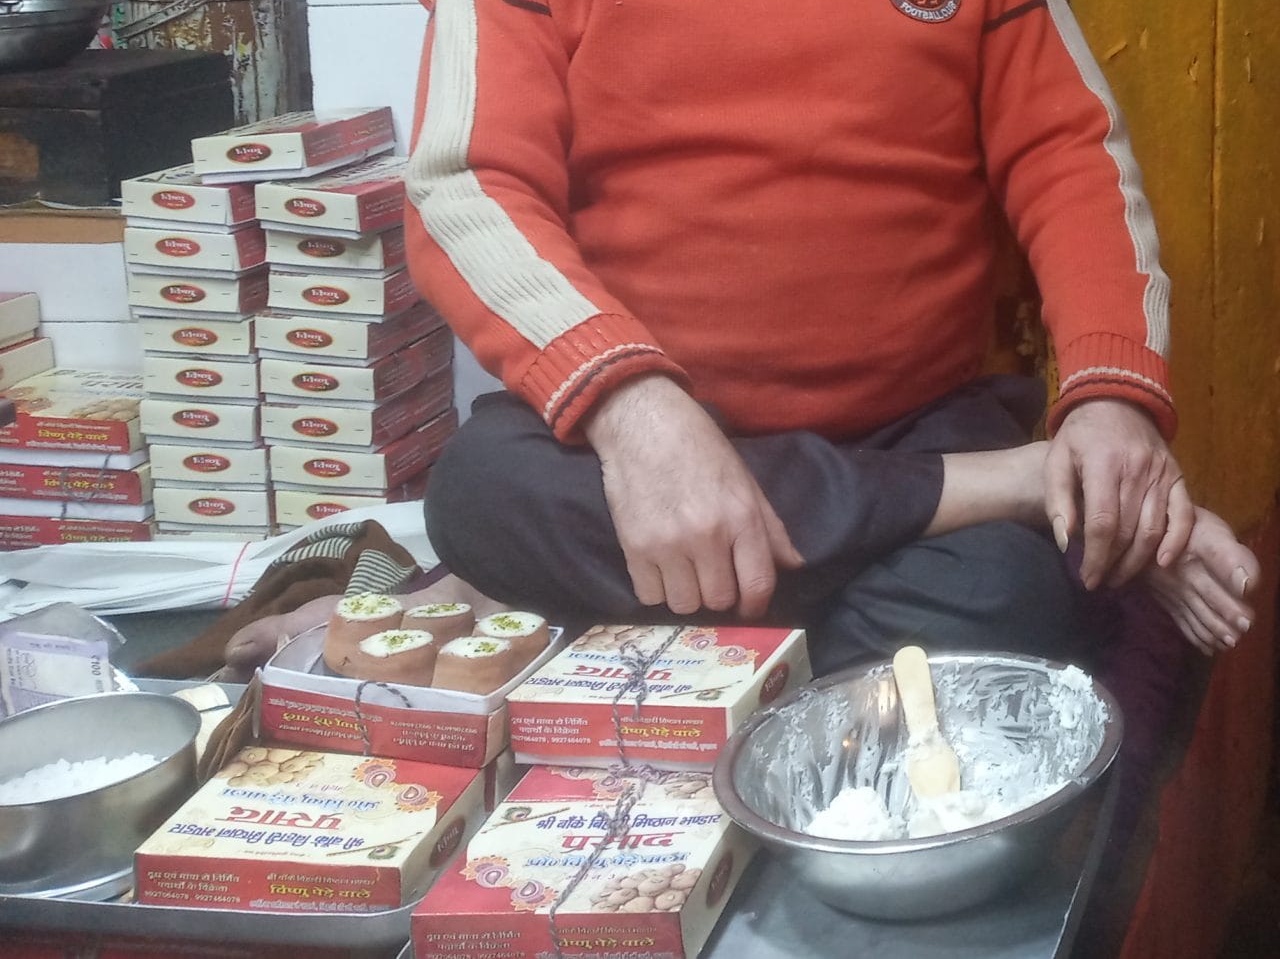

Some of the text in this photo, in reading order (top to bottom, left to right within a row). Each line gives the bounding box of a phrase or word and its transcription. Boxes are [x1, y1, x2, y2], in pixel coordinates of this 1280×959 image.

[214, 806, 345, 831] प्रसाद
[536, 815, 556, 830] श्री
[556, 815, 587, 830] बाँके
[631, 814, 679, 829] मिष्ठान
[680, 813, 723, 826] भण्डार
[168, 823, 216, 836] भण्डार
[216, 825, 266, 844] मिष्ठान
[265, 829, 311, 846] बिहारी
[343, 837, 365, 850] श्री
[147, 871, 162, 880] दूध
[338, 888, 372, 899] वाले
